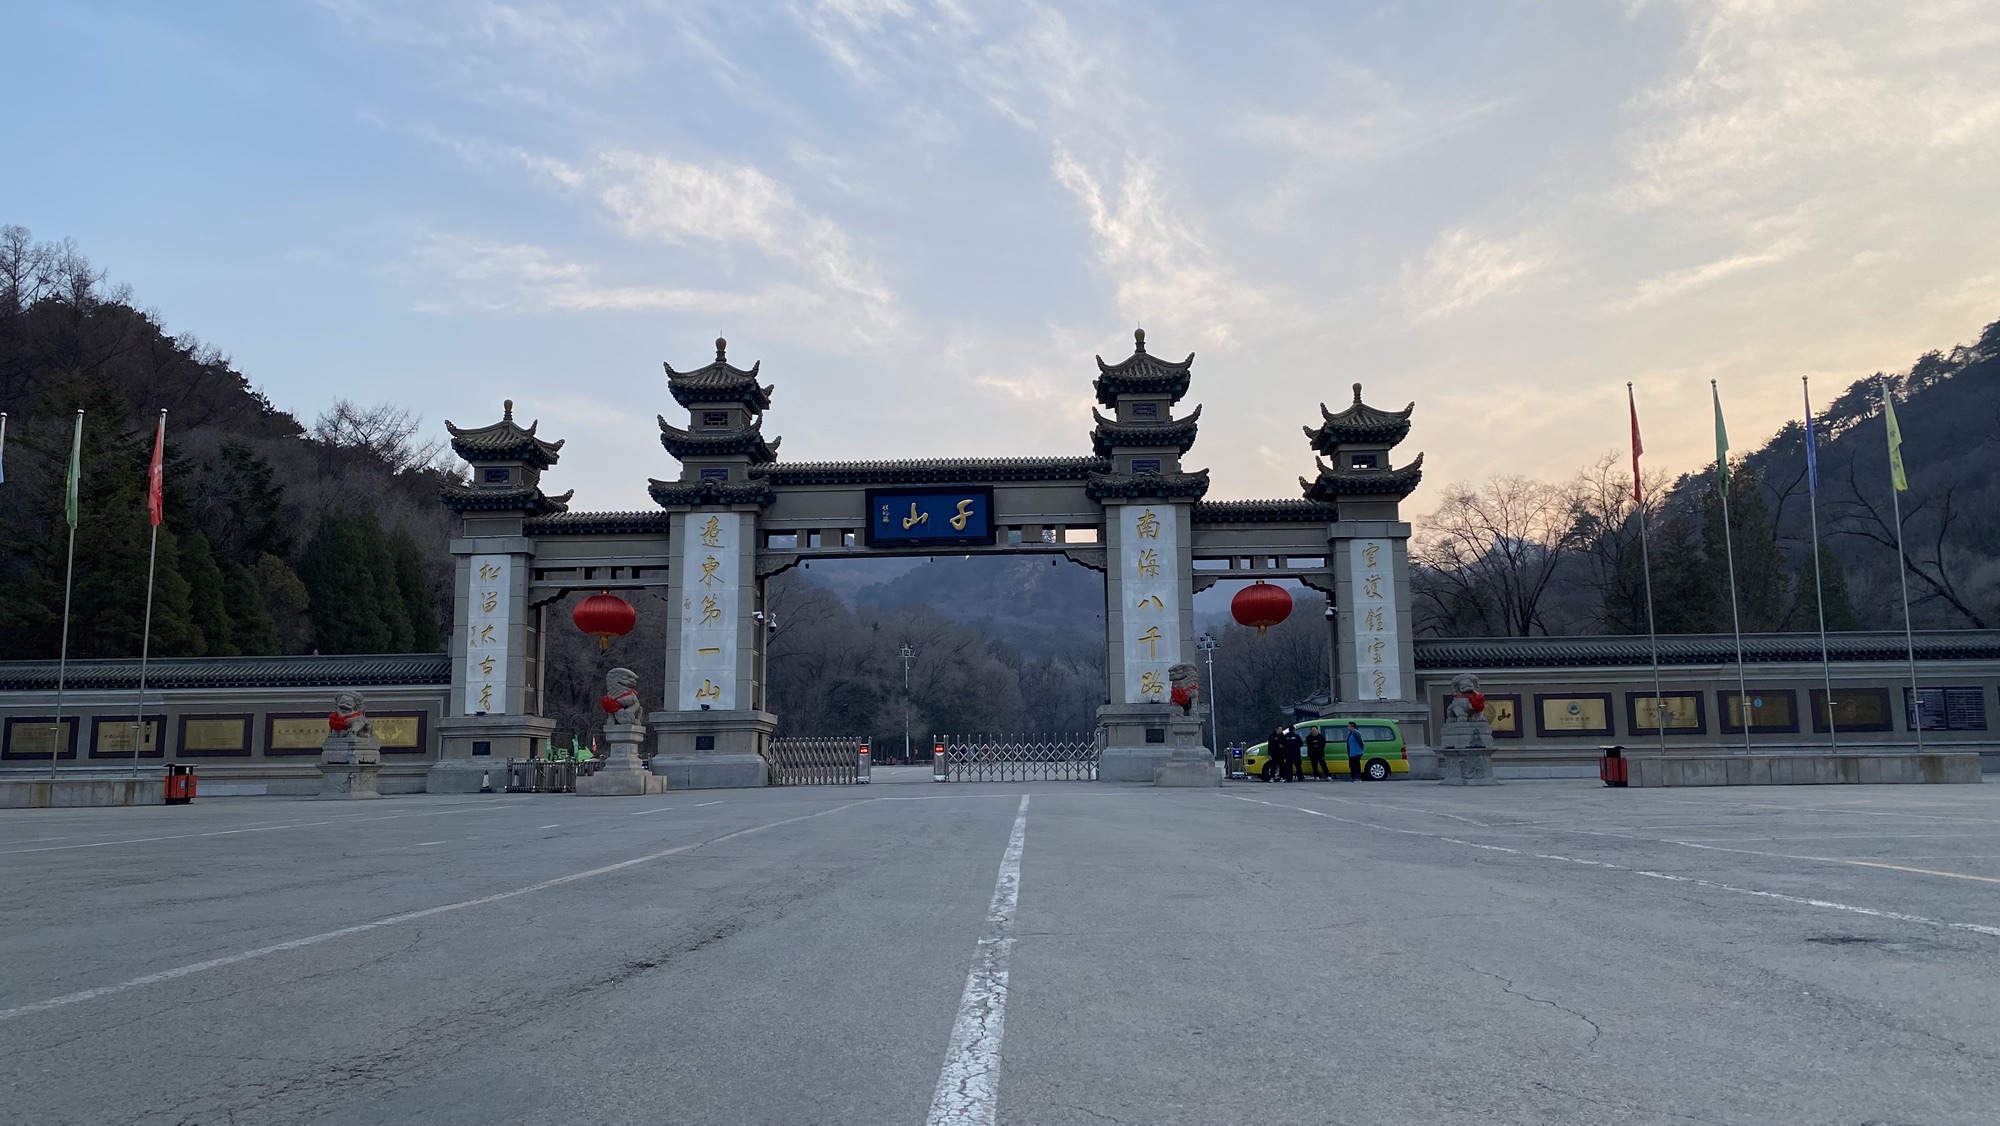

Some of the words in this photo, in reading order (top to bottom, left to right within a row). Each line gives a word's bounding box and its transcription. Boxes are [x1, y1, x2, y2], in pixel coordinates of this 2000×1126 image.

[902, 499, 974, 531] 千山
[1136, 509, 1166, 696] 南海八千路
